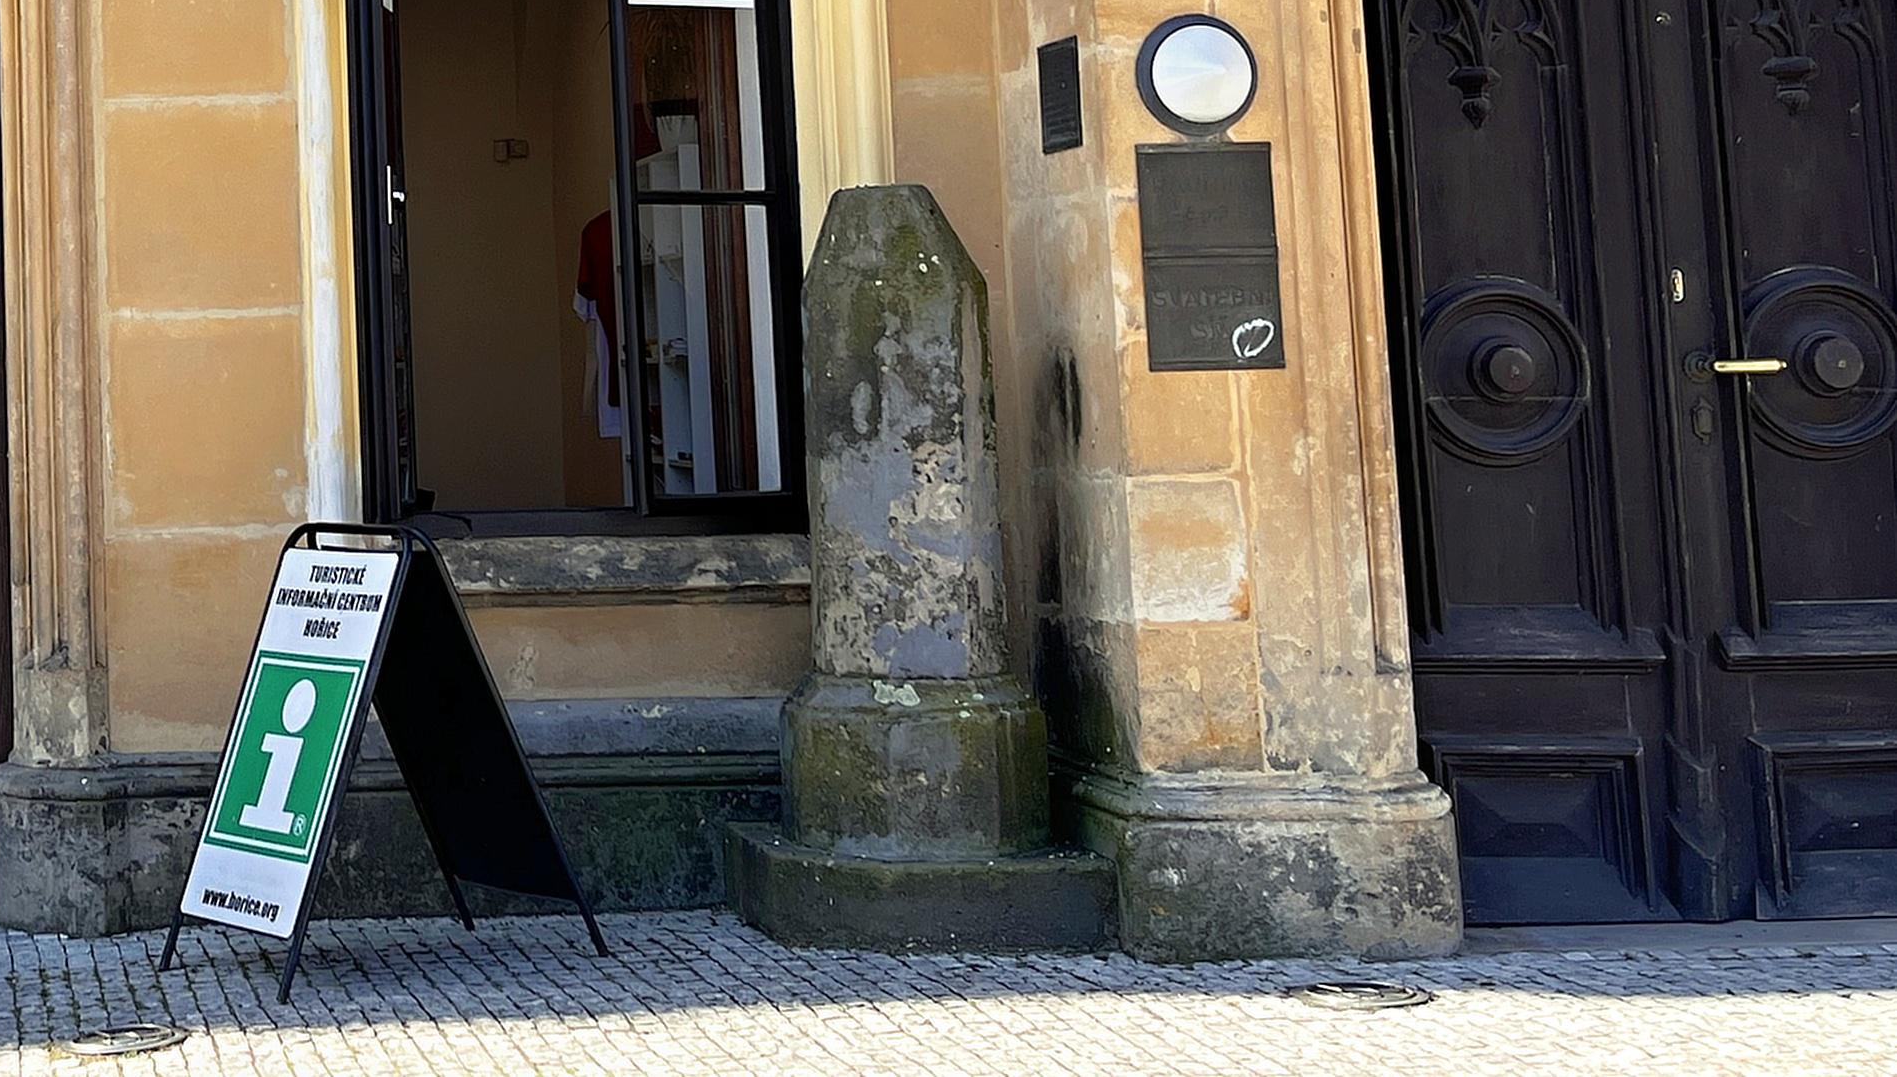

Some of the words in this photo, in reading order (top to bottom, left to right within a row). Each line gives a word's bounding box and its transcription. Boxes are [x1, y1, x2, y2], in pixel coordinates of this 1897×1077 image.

[309, 564, 367, 585] TURISTICKÉ
[276, 588, 340, 609] INFORMAČNÍ
[337, 592, 383, 612] CENTRUM
[303, 617, 341, 639] HOŘICE
[202, 888, 280, 922] www.horice.org
